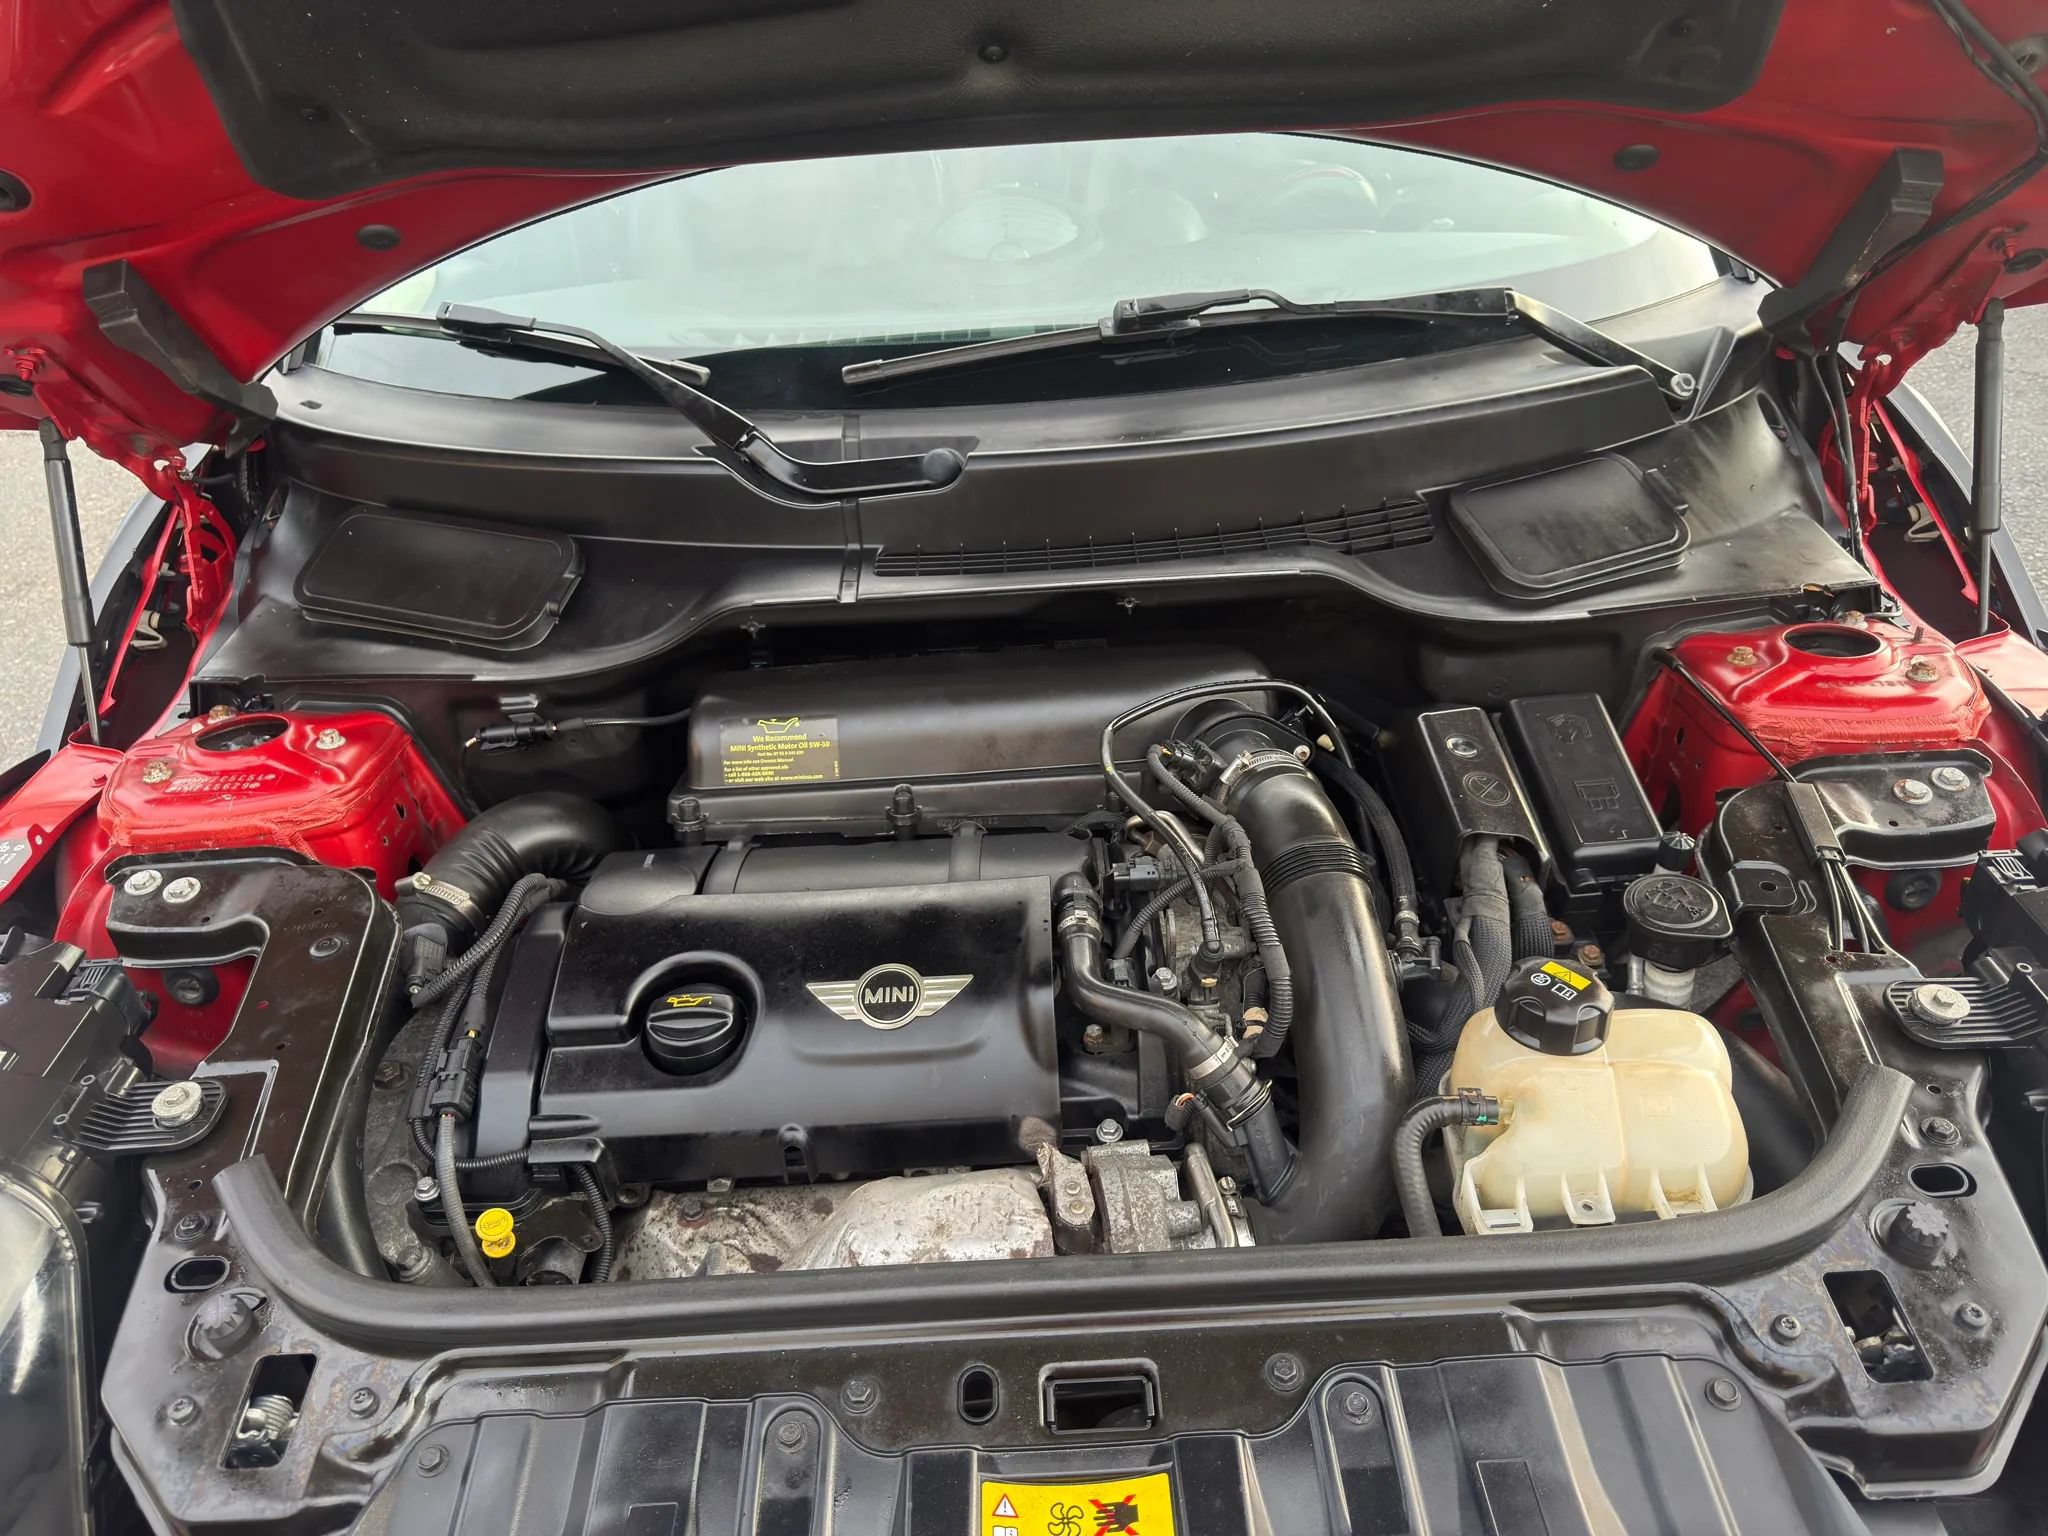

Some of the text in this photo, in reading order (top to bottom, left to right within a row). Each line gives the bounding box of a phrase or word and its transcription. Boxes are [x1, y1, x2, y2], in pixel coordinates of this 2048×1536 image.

[765, 733, 807, 742] Recommend
[730, 744, 746, 752] MINI
[747, 743, 777, 752] Synthetic
[778, 742, 797, 750] Motor
[865, 986, 913, 1004] MINI
